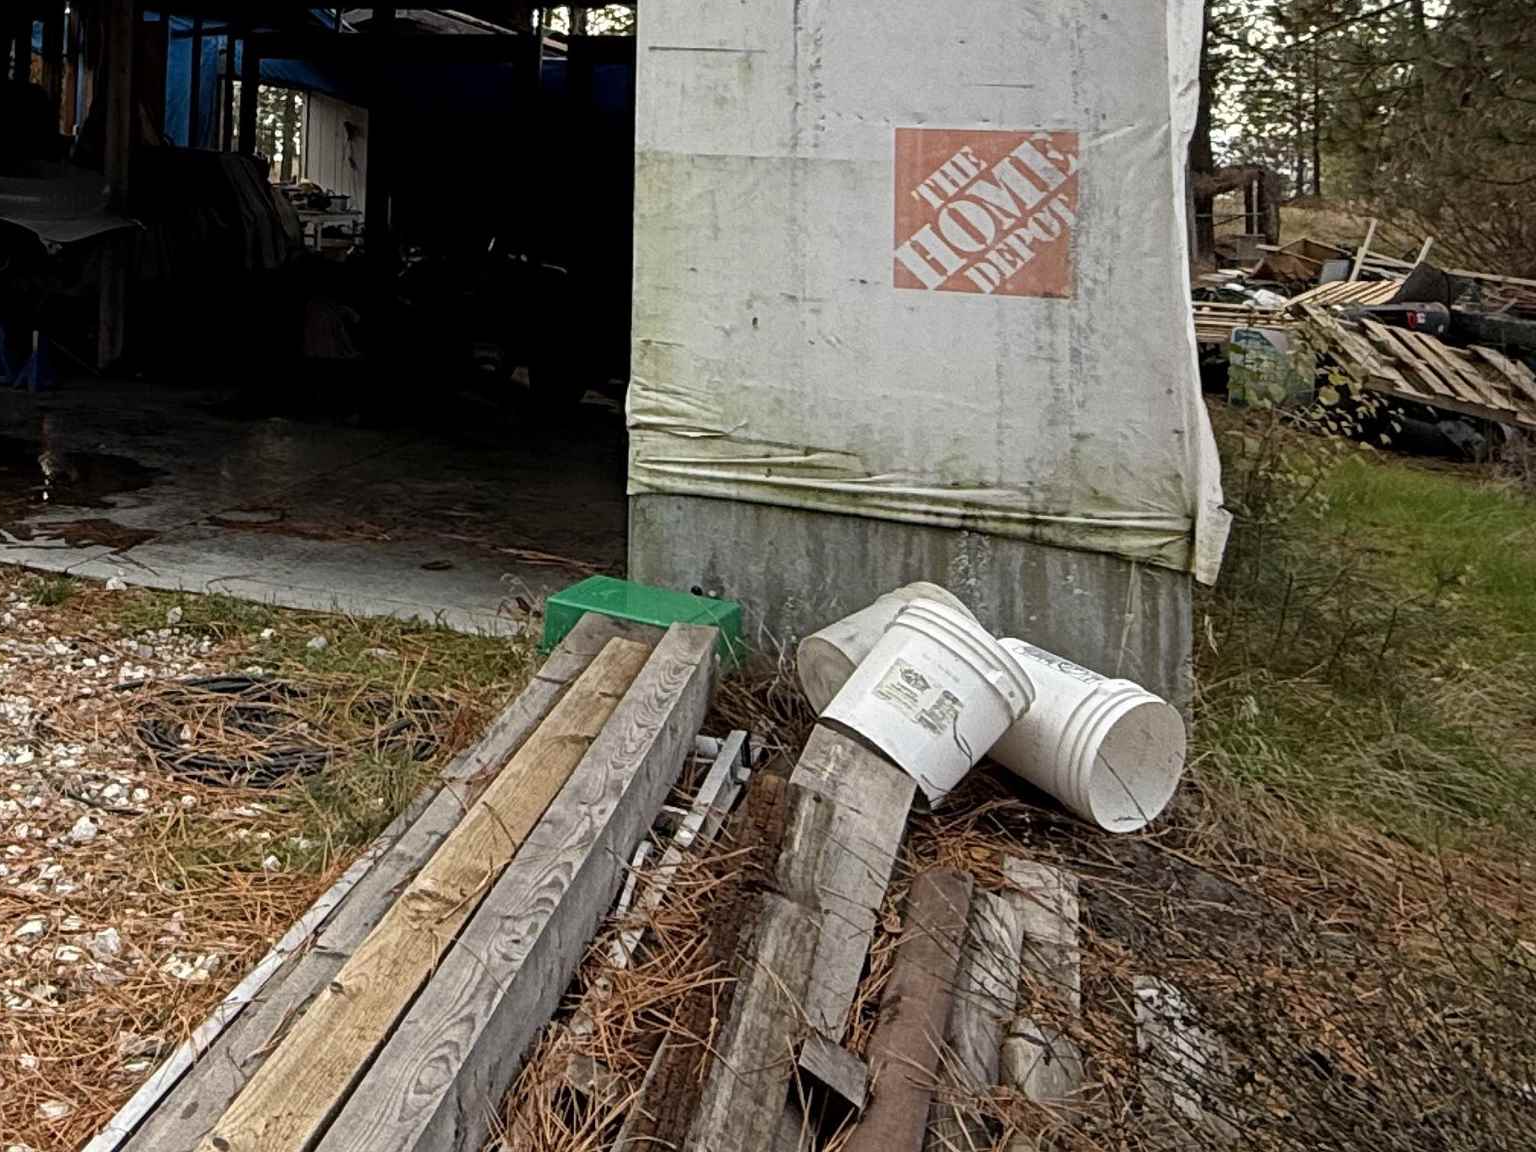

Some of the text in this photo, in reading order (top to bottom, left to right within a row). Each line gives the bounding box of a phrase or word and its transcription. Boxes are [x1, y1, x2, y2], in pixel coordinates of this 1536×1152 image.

[894, 132, 1079, 290] HOME
[911, 146, 987, 209] THE
[964, 193, 1078, 294] DEPOT
